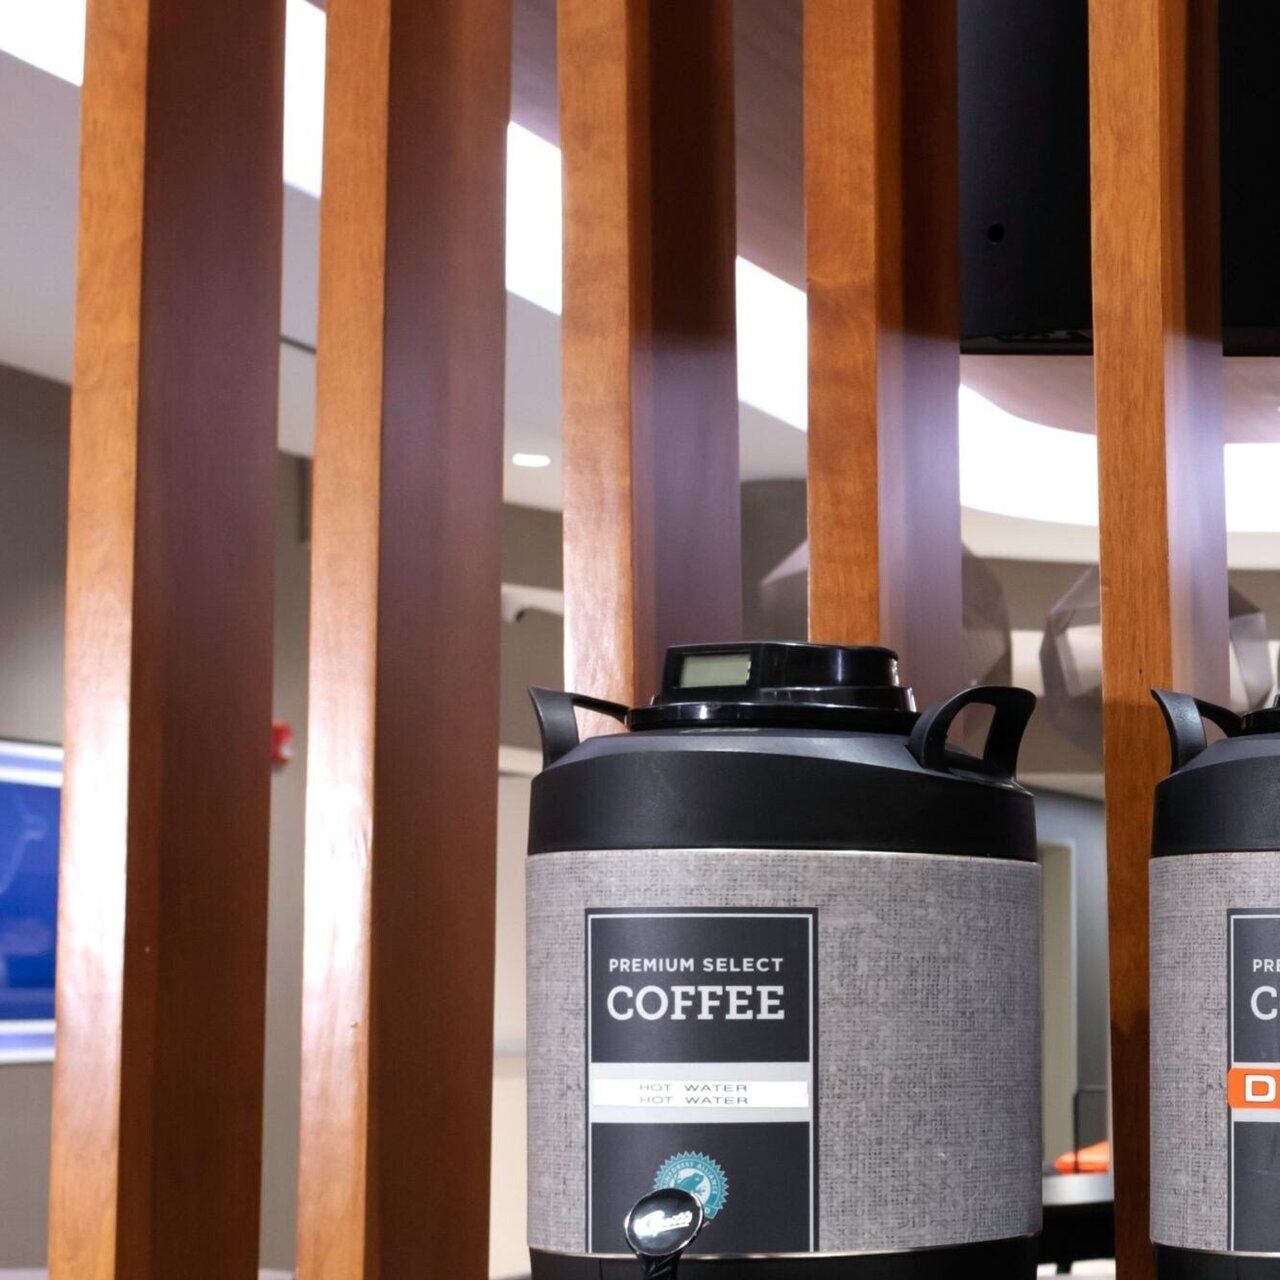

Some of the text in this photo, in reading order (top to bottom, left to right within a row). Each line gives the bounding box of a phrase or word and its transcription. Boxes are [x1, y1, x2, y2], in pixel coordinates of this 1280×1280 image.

[609, 958, 784, 972] PREMIUM SELECT
[607, 985, 785, 1021] COFFEE
[639, 1084, 748, 1092] HOT WATER
[639, 1096, 749, 1104] HOT WATER
[663, 1161, 694, 1185] INFOREST
